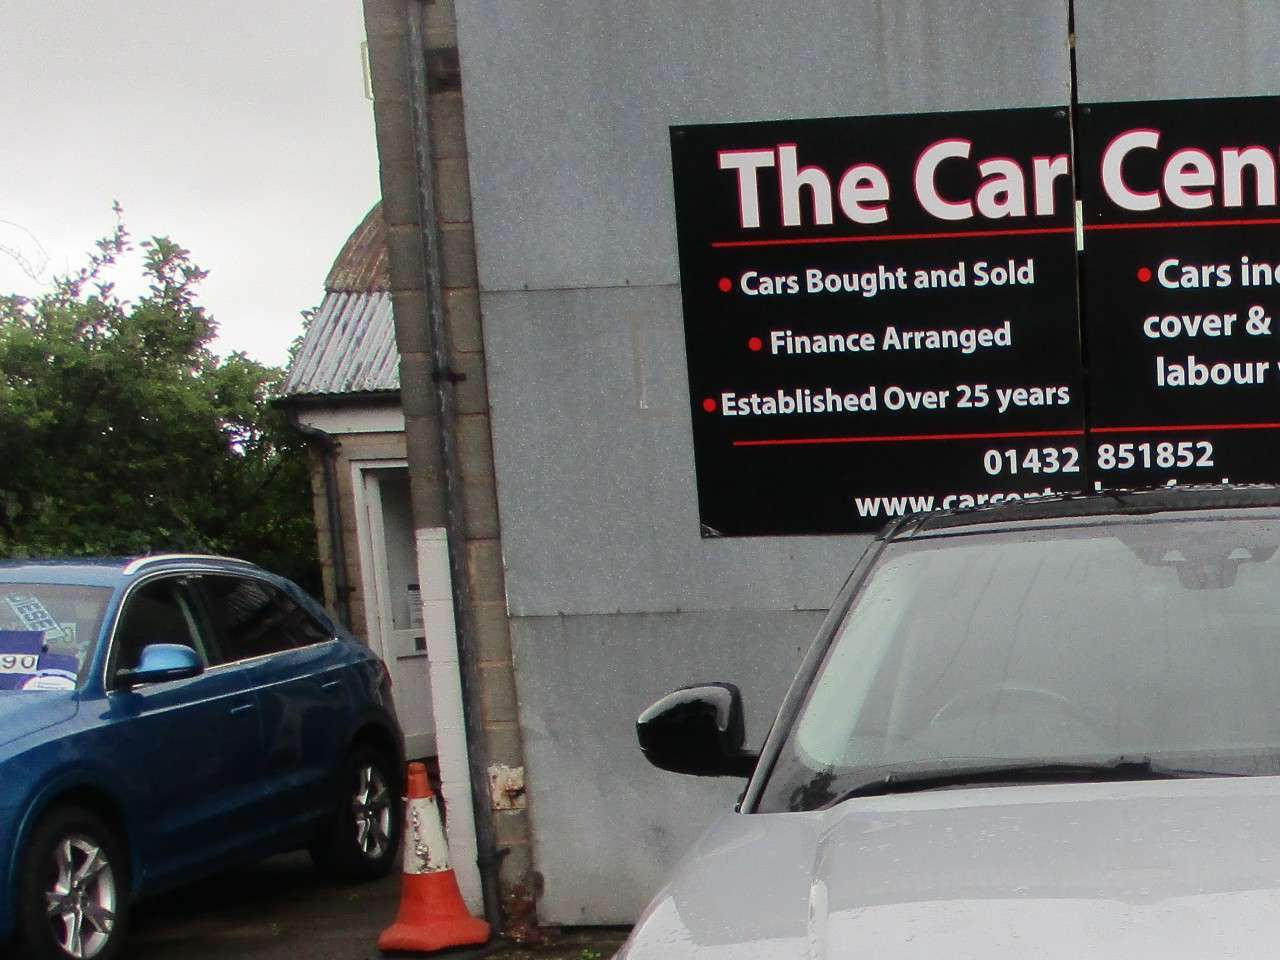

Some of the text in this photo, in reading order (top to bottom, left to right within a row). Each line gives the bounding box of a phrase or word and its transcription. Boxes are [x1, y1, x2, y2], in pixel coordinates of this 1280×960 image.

[717, 143, 890, 229] The
[913, 137, 1069, 221] Car
[740, 258, 1035, 298] Cars Bought and Sold
[1157, 258, 1232, 288] Cars
[770, 320, 1012, 355] Finance Arranged
[1143, 313, 1237, 338] cover
[1245, 305, 1272, 336] &
[1156, 355, 1270, 387] labour
[721, 384, 1070, 416] Established Over 25 years
[983, 440, 1214, 475] 01432 851852
